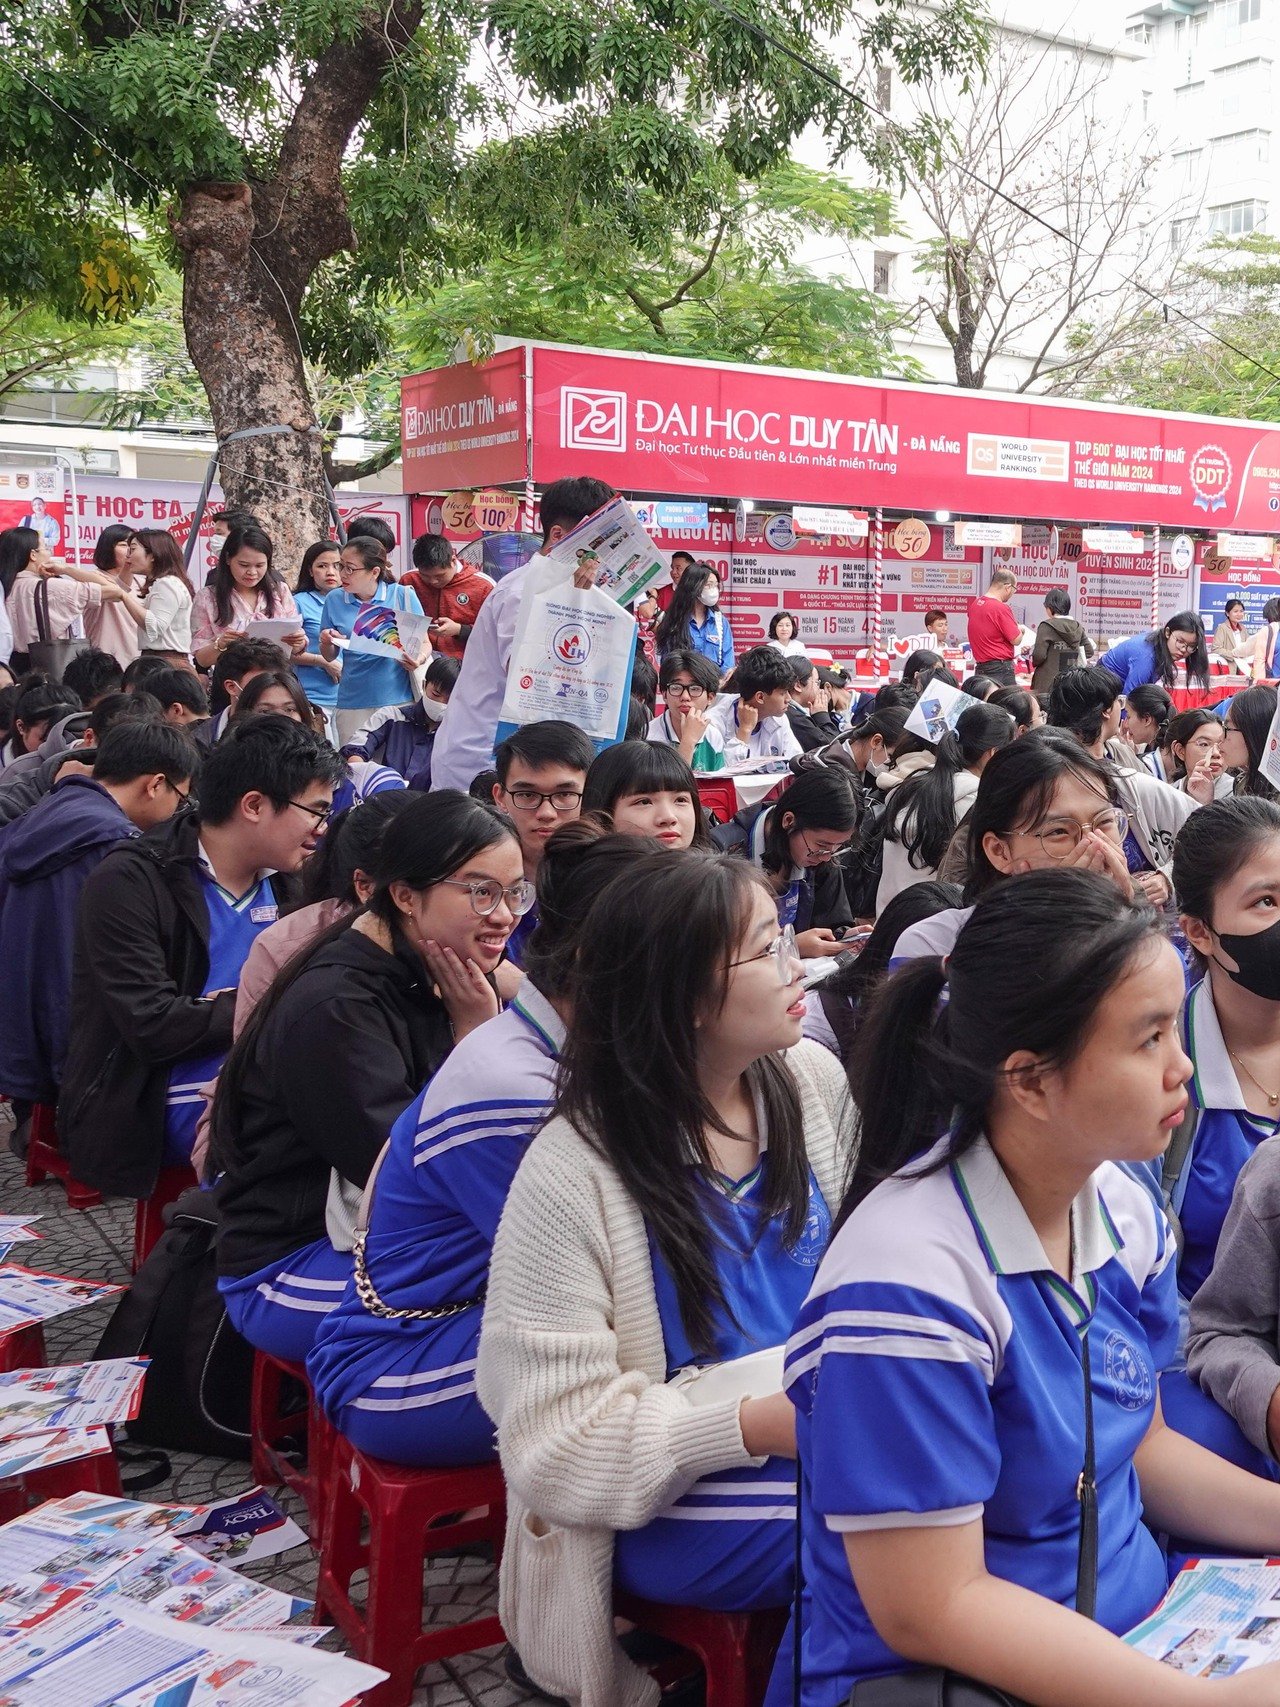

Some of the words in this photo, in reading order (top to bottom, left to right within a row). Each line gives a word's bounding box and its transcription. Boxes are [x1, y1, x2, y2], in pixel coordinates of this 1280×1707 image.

[435, 404, 457, 431] HỌC
[458, 401, 476, 428] DUY
[476, 394, 494, 424] TÂN
[635, 400, 697, 437] ĐẠI
[706, 406, 781, 445] HỌC
[789, 414, 844, 450] DUY
[847, 418, 899, 456] TÂN
[910, 435, 926, 451] ĐÀ
[930, 435, 961, 454] NẴNG
[1001, 442, 1028, 452] WORLD
[1075, 441, 1092, 455] TOP
[1115, 444, 1130, 460] ĐẠI
[1131, 446, 1148, 462] HỌC
[1149, 445, 1164, 462] TỐT
[1165, 447, 1186, 463] NHẤT
[635, 438, 655, 454] Đại
[659, 440, 680, 456] học
[682, 442, 699, 456] Tư
[700, 443, 726, 460] thục
[728, 446, 752, 460] Đầu
[754, 448, 776, 462] tiên
[778, 451, 787, 463] &
[789, 452, 810, 465] Lớn
[812, 453, 836, 467] nhất
[839, 456, 865, 469] miền
[867, 459, 897, 475] Trung
[975, 447, 995, 465] QS
[1001, 453, 1042, 463] UNIVERSITY
[1000, 464, 1037, 474] RANKINGS
[1074, 458, 1093, 475] THẾ
[1092, 461, 1109, 476] GIỚI
[1110, 461, 1130, 478] NĂM
[1131, 466, 1153, 480] 2024
[1195, 466, 1225, 485] DDT
[1074, 478, 1087, 488] THEO
[1088, 479, 1095, 489] QS
[1096, 480, 1114, 490] WORLD
[1114, 481, 1144, 492] UNIVERSITY
[1144, 483, 1169, 494] RANKINGS
[1168, 485, 1182, 495] 2024
[479, 494, 494, 506] Học
[96, 496, 144, 523] HỌC
[667, 518, 734, 545] NGUYỆN
[896, 528, 909, 536] Học
[900, 537, 923, 553] 50
[1063, 542, 1081, 559] 100
[733, 557, 743, 566] ĐẠI
[745, 558, 758, 567] HỌC
[842, 563, 852, 571] ĐẠI
[853, 564, 866, 572] HỌC
[1085, 554, 1114, 568] TUYỂN
[1115, 556, 1134, 570] SINH
[733, 567, 748, 575] PHÁT
[749, 567, 767, 576] TRIỂN
[768, 568, 779, 576] BỀN
[780, 568, 796, 577] VỮNG
[817, 564, 838, 586] #1
[842, 572, 857, 580] PHÁT
[858, 572, 874, 581] TRIỂN
[886, 573, 901, 582] VỮNG
[1022, 565, 1038, 579] HỌC
[1039, 566, 1054, 578] DUY
[1055, 564, 1069, 579] TÂN
[1227, 572, 1242, 582] HỌC
[733, 576, 748, 584] NHẤT
[749, 576, 766, 584] CHÂU
[859, 581, 870, 589] VIỆT
[802, 625, 813, 633] TIẾN
[813, 624, 818, 633] SĨ
[822, 616, 837, 634] 15
[838, 617, 855, 625] NGÀNH
[838, 625, 850, 633] THẠC
[887, 627, 897, 635] HỌC
[888, 637, 894, 651] I
[911, 636, 936, 652] DTU
[223, 1507, 275, 1528] TROY
